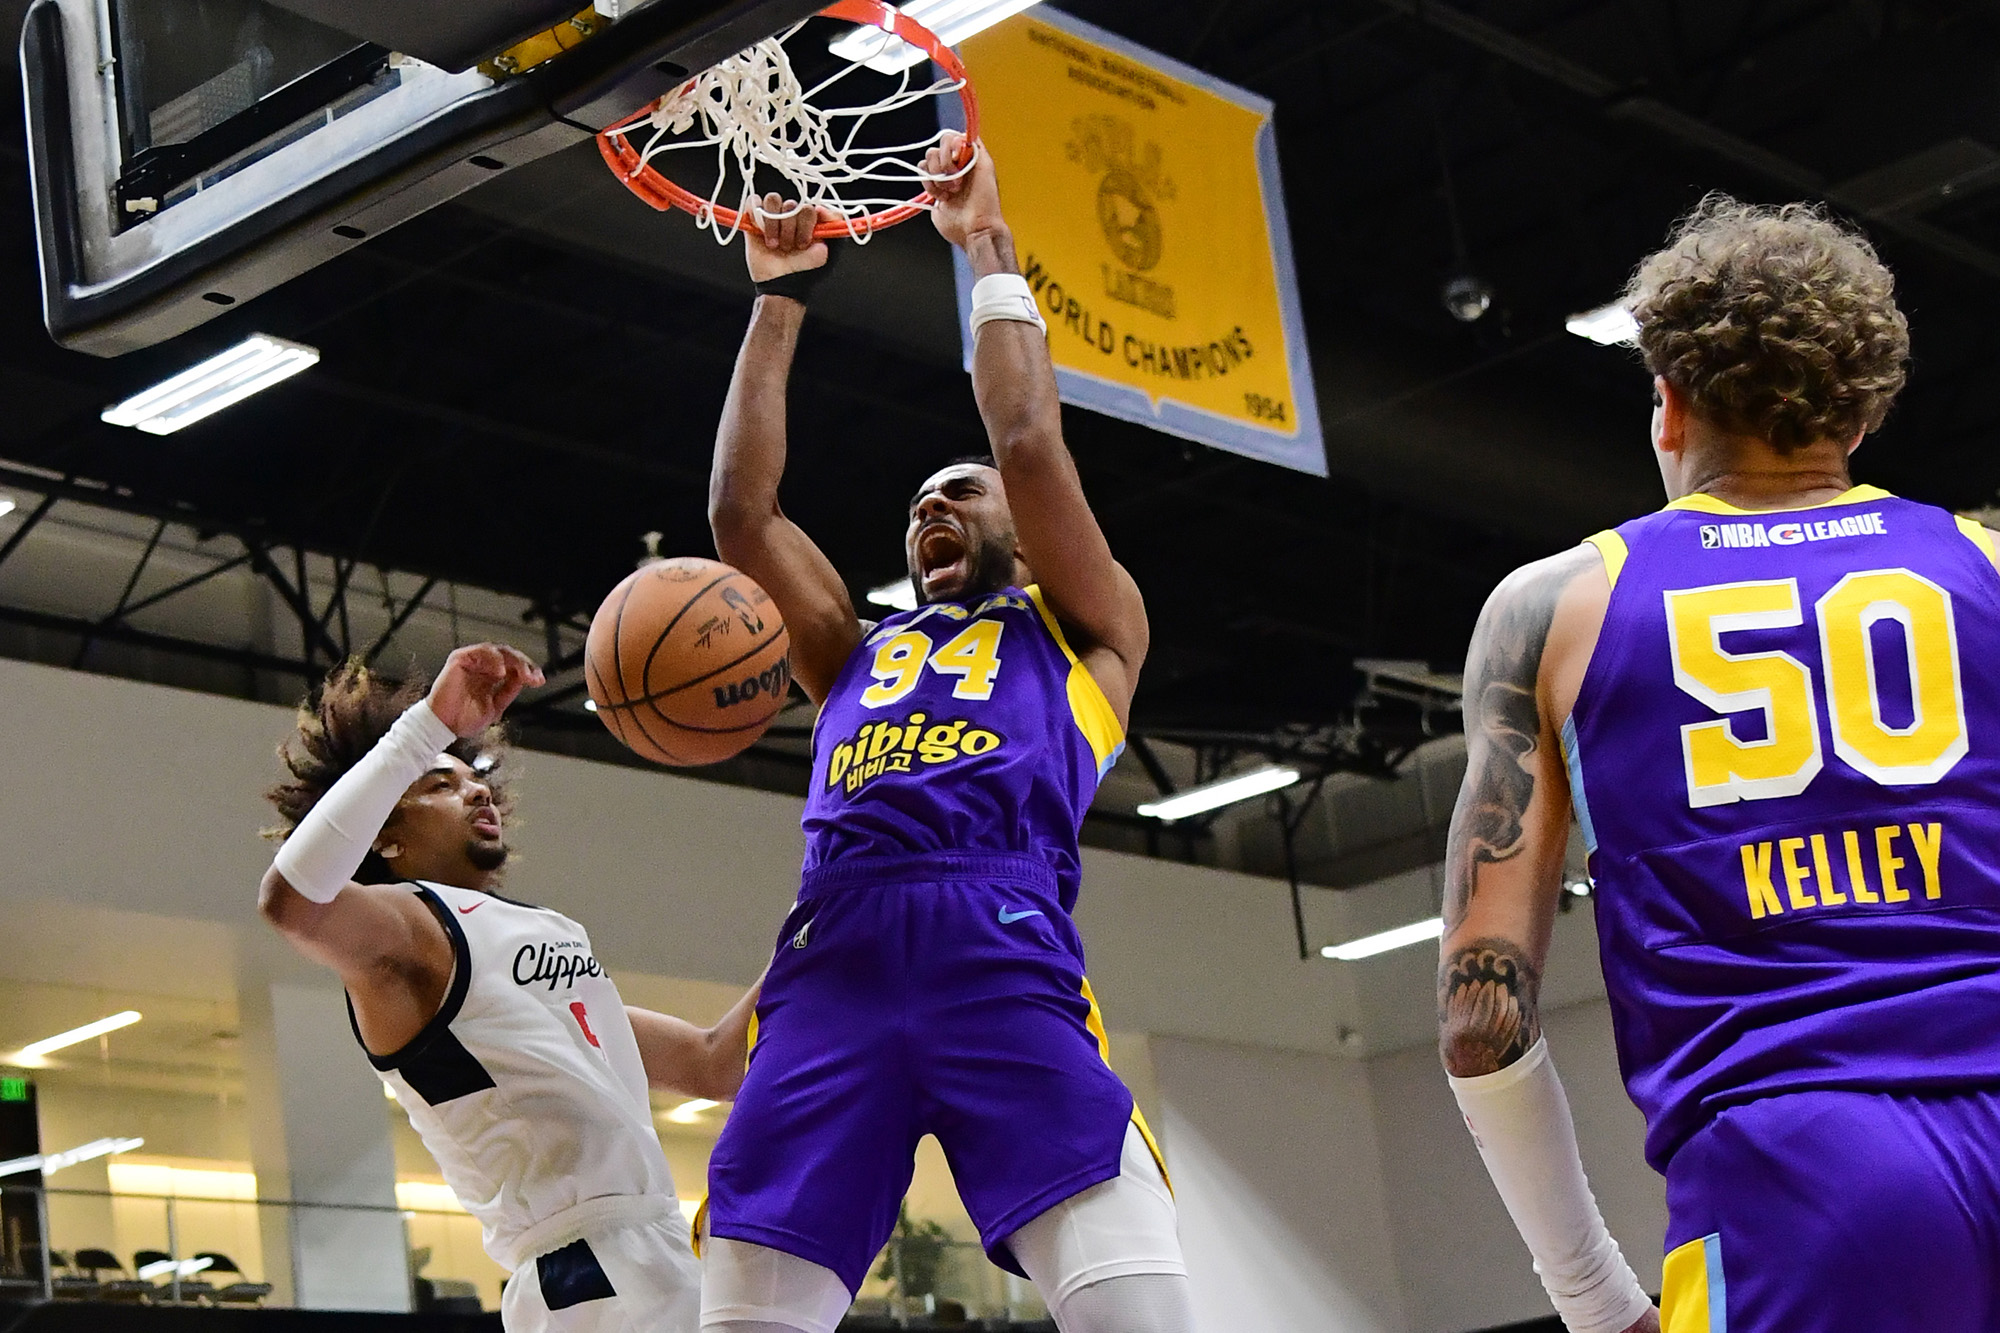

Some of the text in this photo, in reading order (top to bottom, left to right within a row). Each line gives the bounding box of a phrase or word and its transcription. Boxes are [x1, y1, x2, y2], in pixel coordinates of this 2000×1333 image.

[1024, 254, 1254, 380] WORLD CHAMPIONS
[1720, 523, 1770, 548] NBA
[1804, 512, 1887, 542] LEAGUE
[859, 618, 1006, 710] 94
[1663, 567, 1970, 809] 50
[829, 712, 1001, 787] bibigo
[846, 752, 912, 794] 비비고
[1740, 822, 1943, 920] KELLEY
